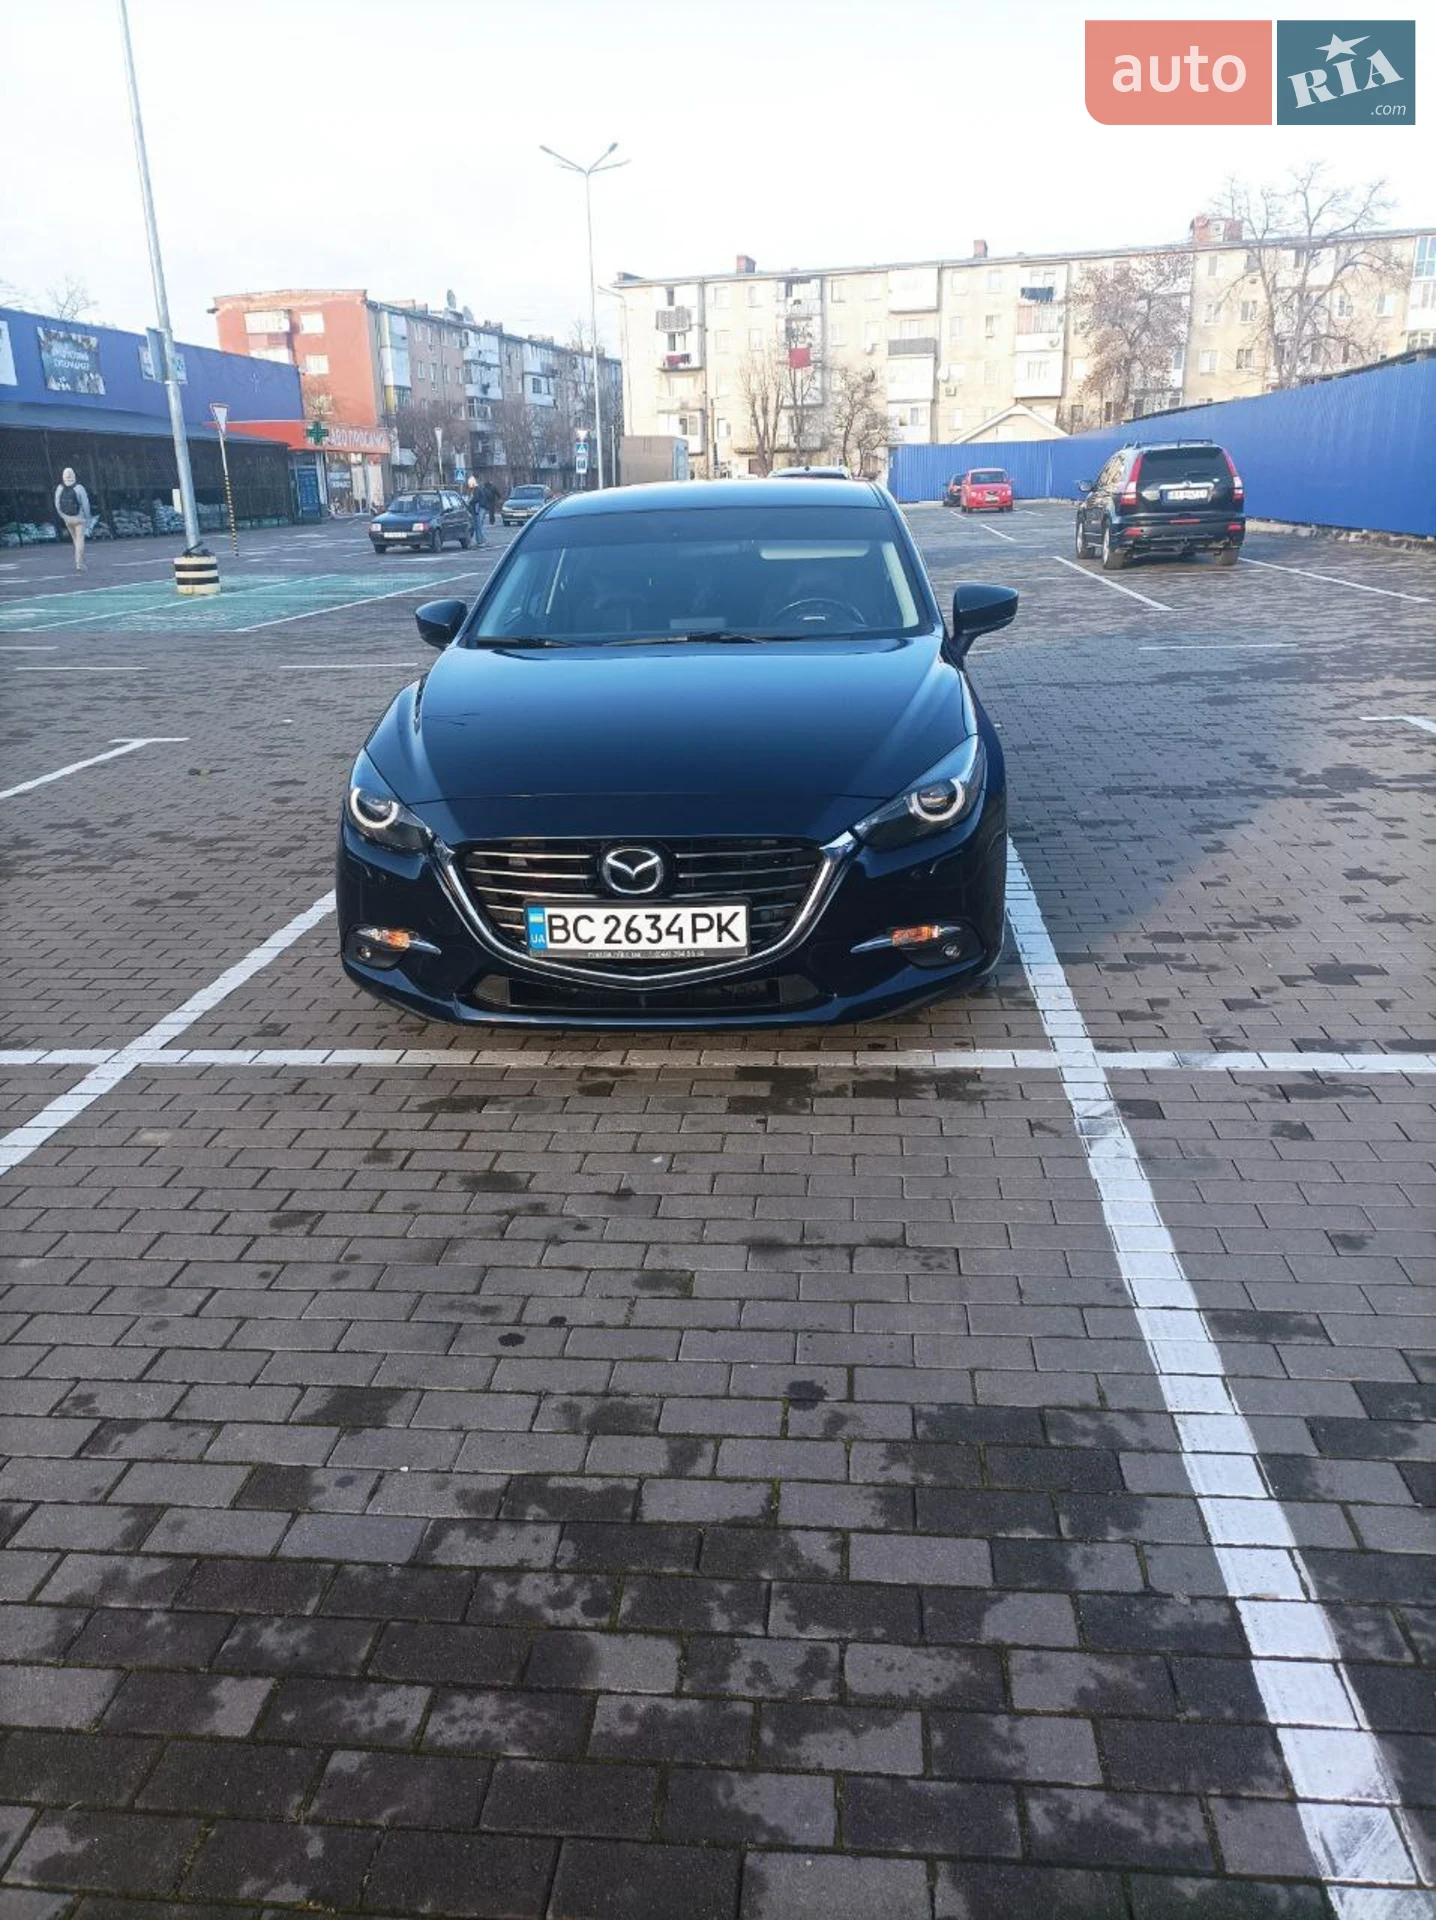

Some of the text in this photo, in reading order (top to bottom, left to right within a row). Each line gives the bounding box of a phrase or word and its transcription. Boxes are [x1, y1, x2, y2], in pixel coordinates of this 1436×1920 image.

[547, 911, 741, 944] BC 2634 PK
[530, 934, 546, 944] UA
